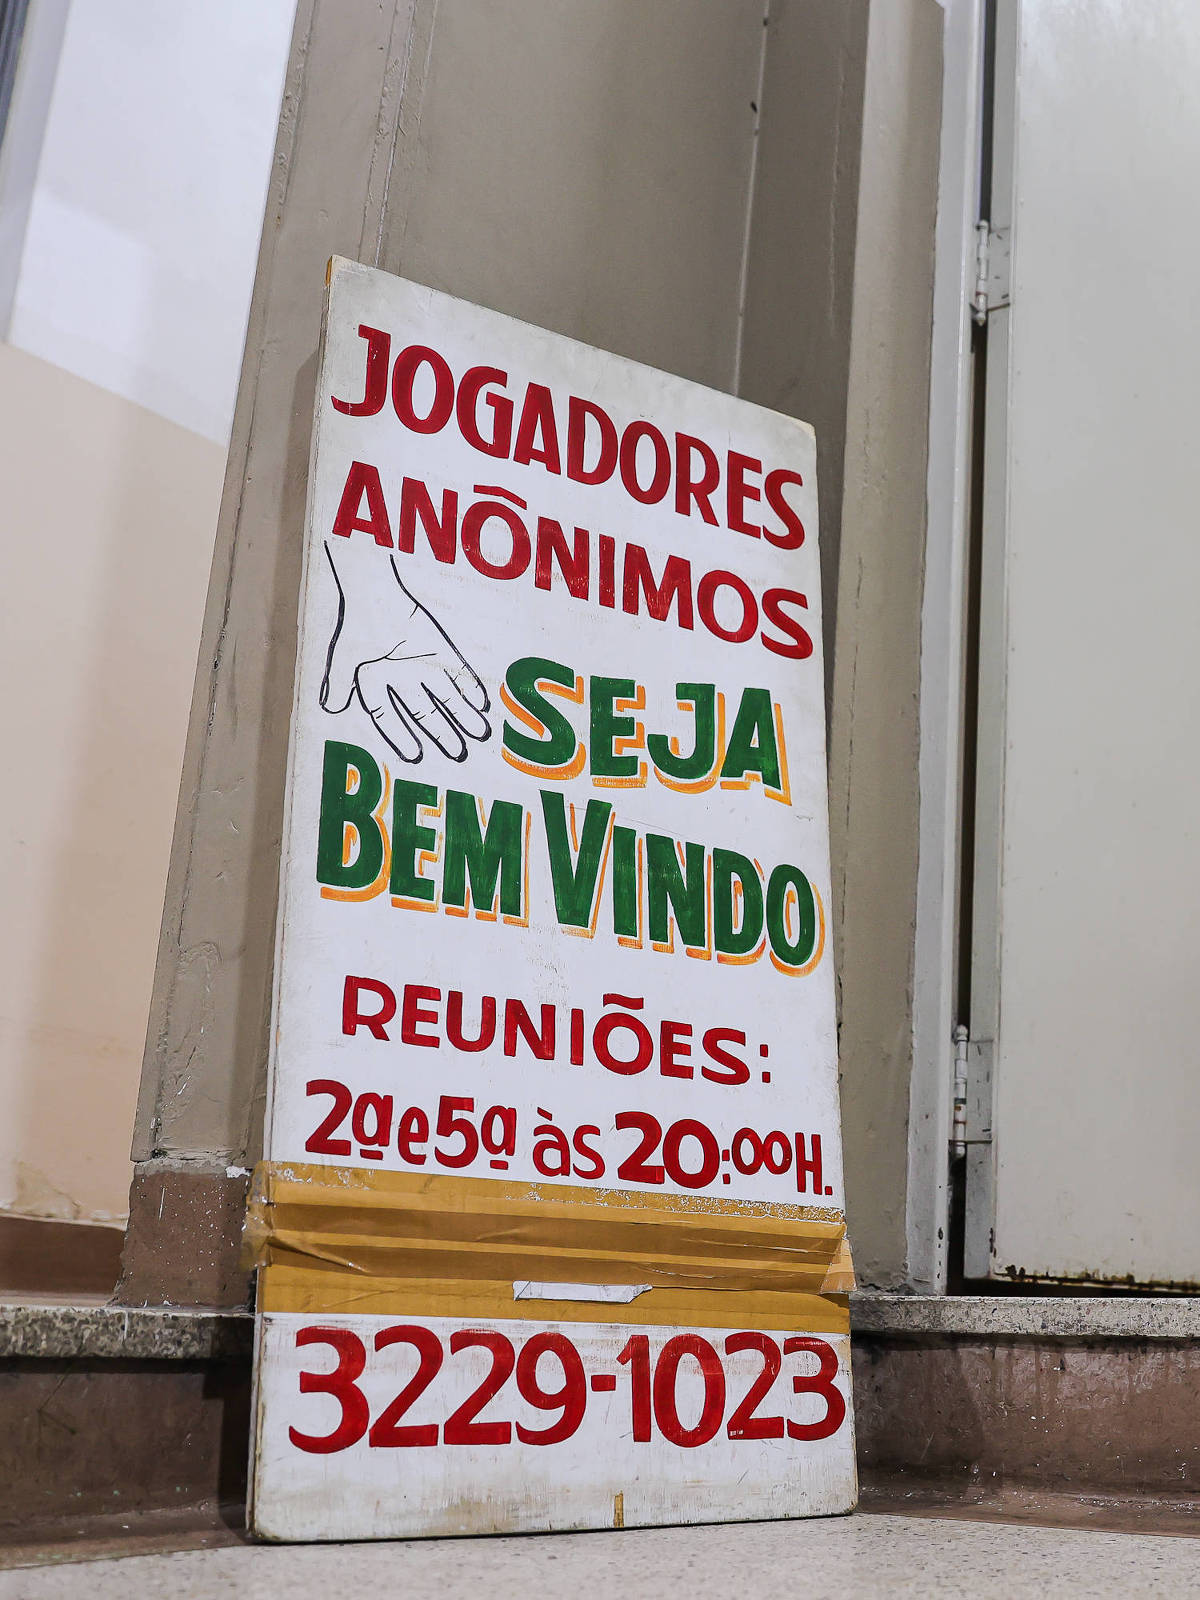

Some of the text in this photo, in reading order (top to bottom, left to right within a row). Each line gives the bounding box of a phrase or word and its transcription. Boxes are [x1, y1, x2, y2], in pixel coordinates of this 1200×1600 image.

[331, 324, 806, 551] JOGADORES
[332, 461, 815, 660] ANÔNIMOS
[500, 656, 793, 806] SEJA
[316, 739, 826, 978] BEM VINDO
[342, 975, 772, 1086] REUNIÕES:
[532, 1106, 606, 1181] às
[287, 1324, 847, 1455] 3229-1023
